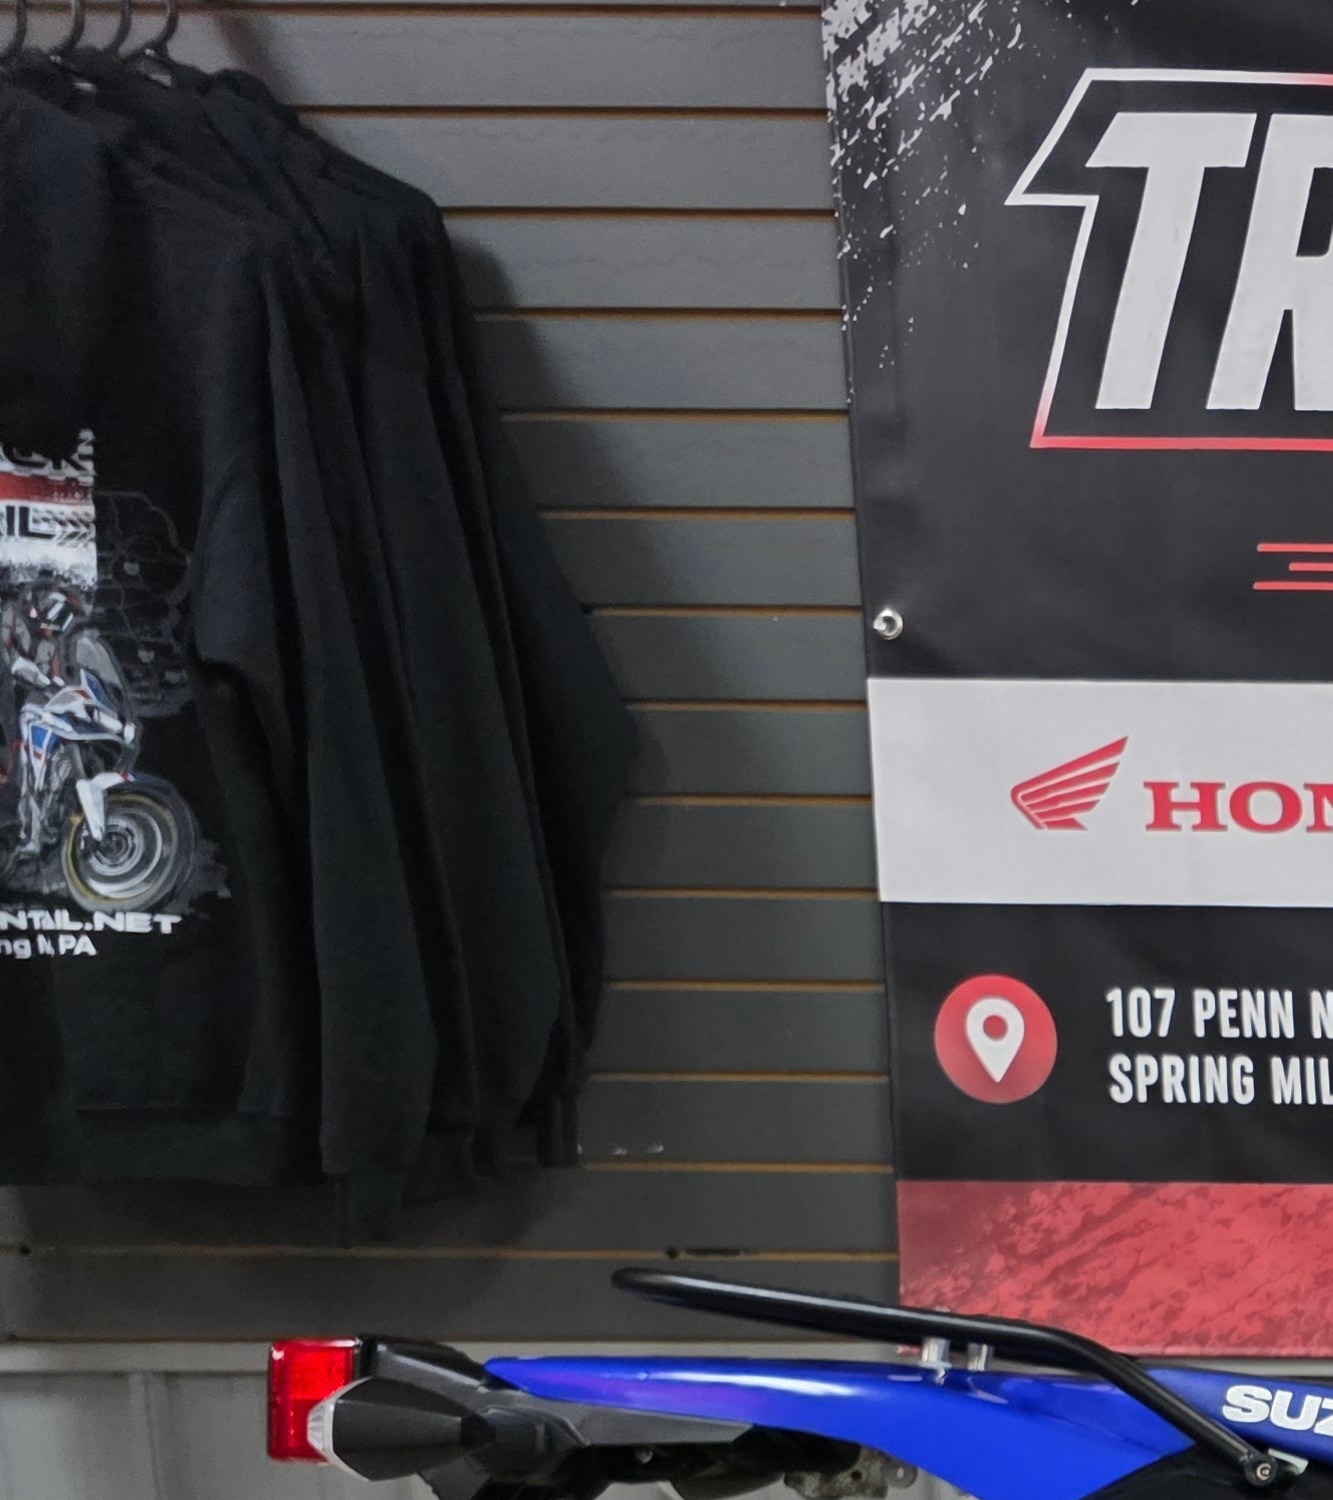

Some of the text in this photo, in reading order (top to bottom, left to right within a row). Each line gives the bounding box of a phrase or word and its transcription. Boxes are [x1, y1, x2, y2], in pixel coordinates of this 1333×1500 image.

[58, 934, 97, 956] PA
[1106, 987, 1176, 1038] 107
[1193, 988, 1295, 1039] PENN
[1108, 1053, 1255, 1105] SPRING
